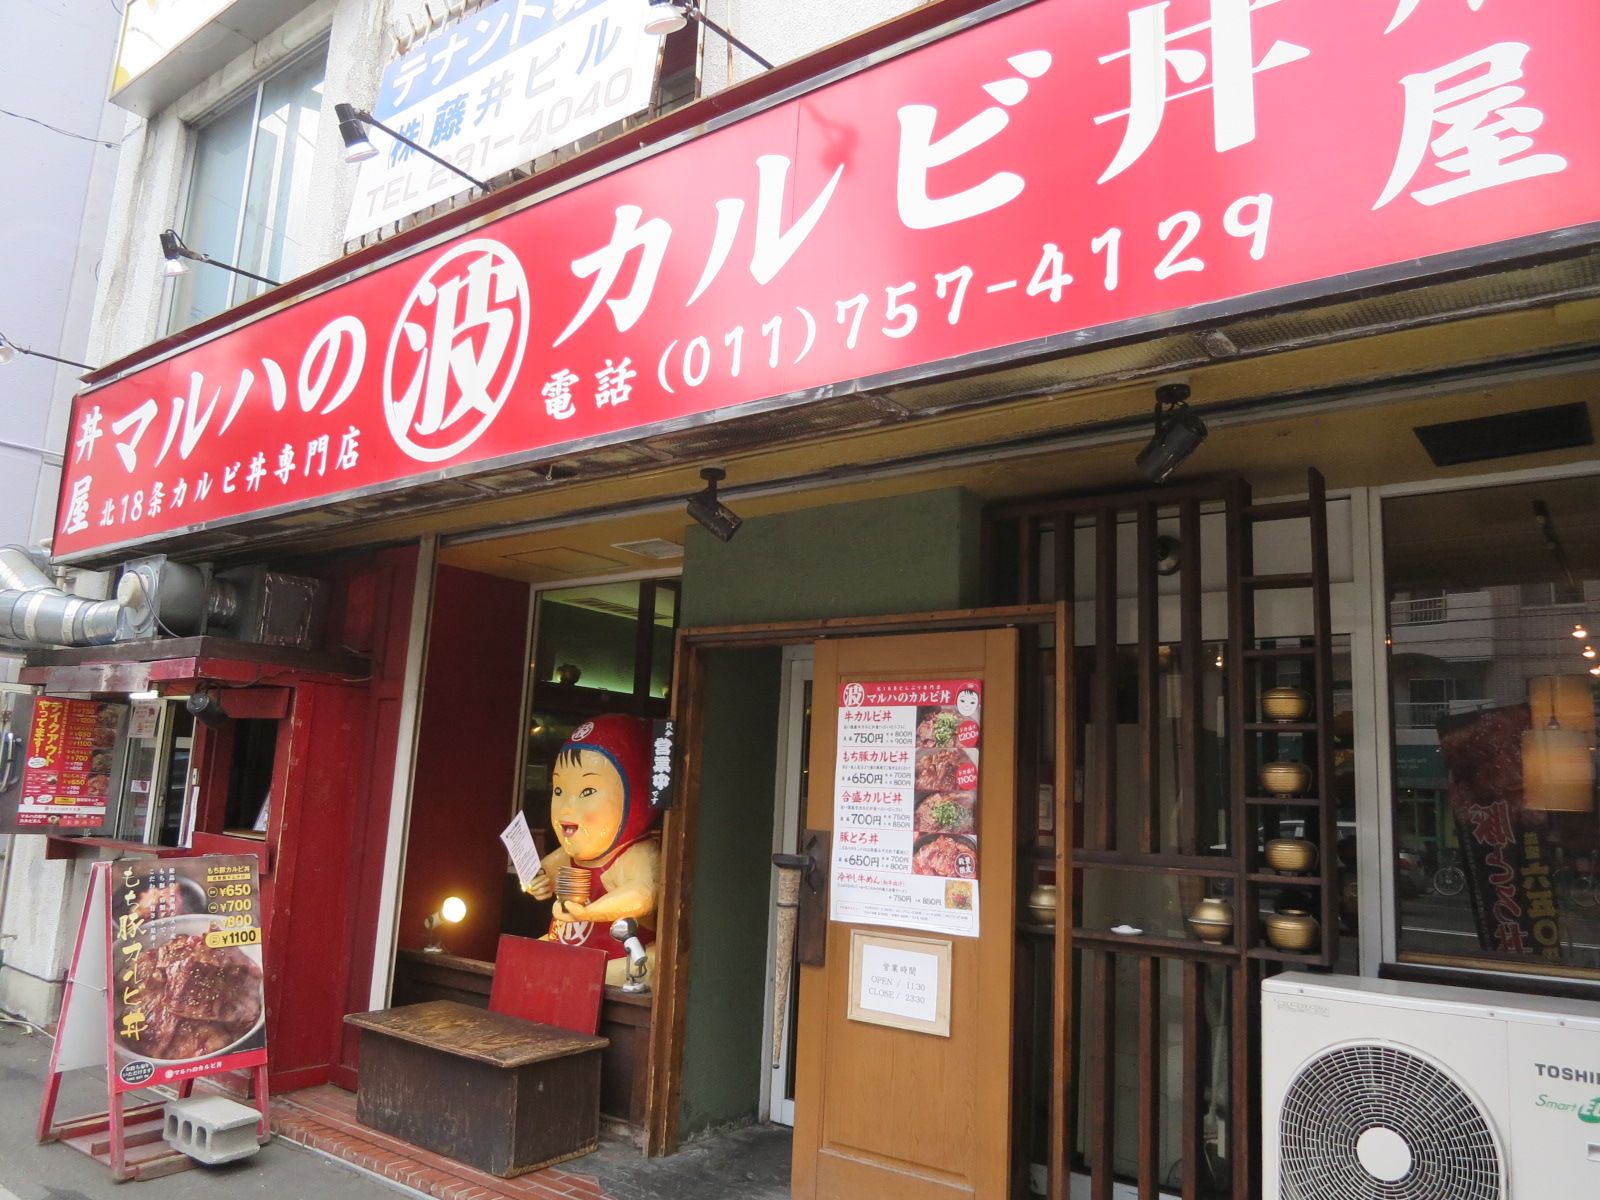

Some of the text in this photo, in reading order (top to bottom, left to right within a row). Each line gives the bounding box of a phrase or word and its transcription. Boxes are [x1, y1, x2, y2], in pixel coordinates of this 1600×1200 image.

[1371, 0, 1568, 211] 屋
[367, 172, 418, 218] TEL
[112, 316, 366, 473] マルハの
[553, 0, 1310, 347] カルビ丼
[541, 357, 636, 420] 電話
[62, 406, 103, 535] 丼屋
[100, 426, 360, 527] 北18条カルビ丼専門店
[867, 690, 951, 703] マルハのカルビ丼
[844, 710, 892, 722] 牛カルビ丼
[45, 701, 63, 767] テイクアウト
[854, 733, 883, 744] 750円
[843, 751, 909, 763] もち豚カルビ丼
[852, 773, 882, 785] 650円
[841, 791, 903, 804] 合盛カルビ丼
[851, 813, 881, 825] 700円
[840, 832, 879, 844] 豚とろ丼
[849, 855, 879, 867] 650円
[208, 866, 250, 875] もち豚カルビ丼
[220, 884, 251, 897] ¥650
[220, 899, 252, 912] ¥700
[222, 930, 256, 944] ¥1100
[117, 867, 148, 1041] もち豚カルビ丼
[883, 963, 917, 976] 営業時間
[871, 975, 893, 985] OPEN
[868, 987, 895, 999] CLOSE
[1536, 1094, 1577, 1112] Smart
